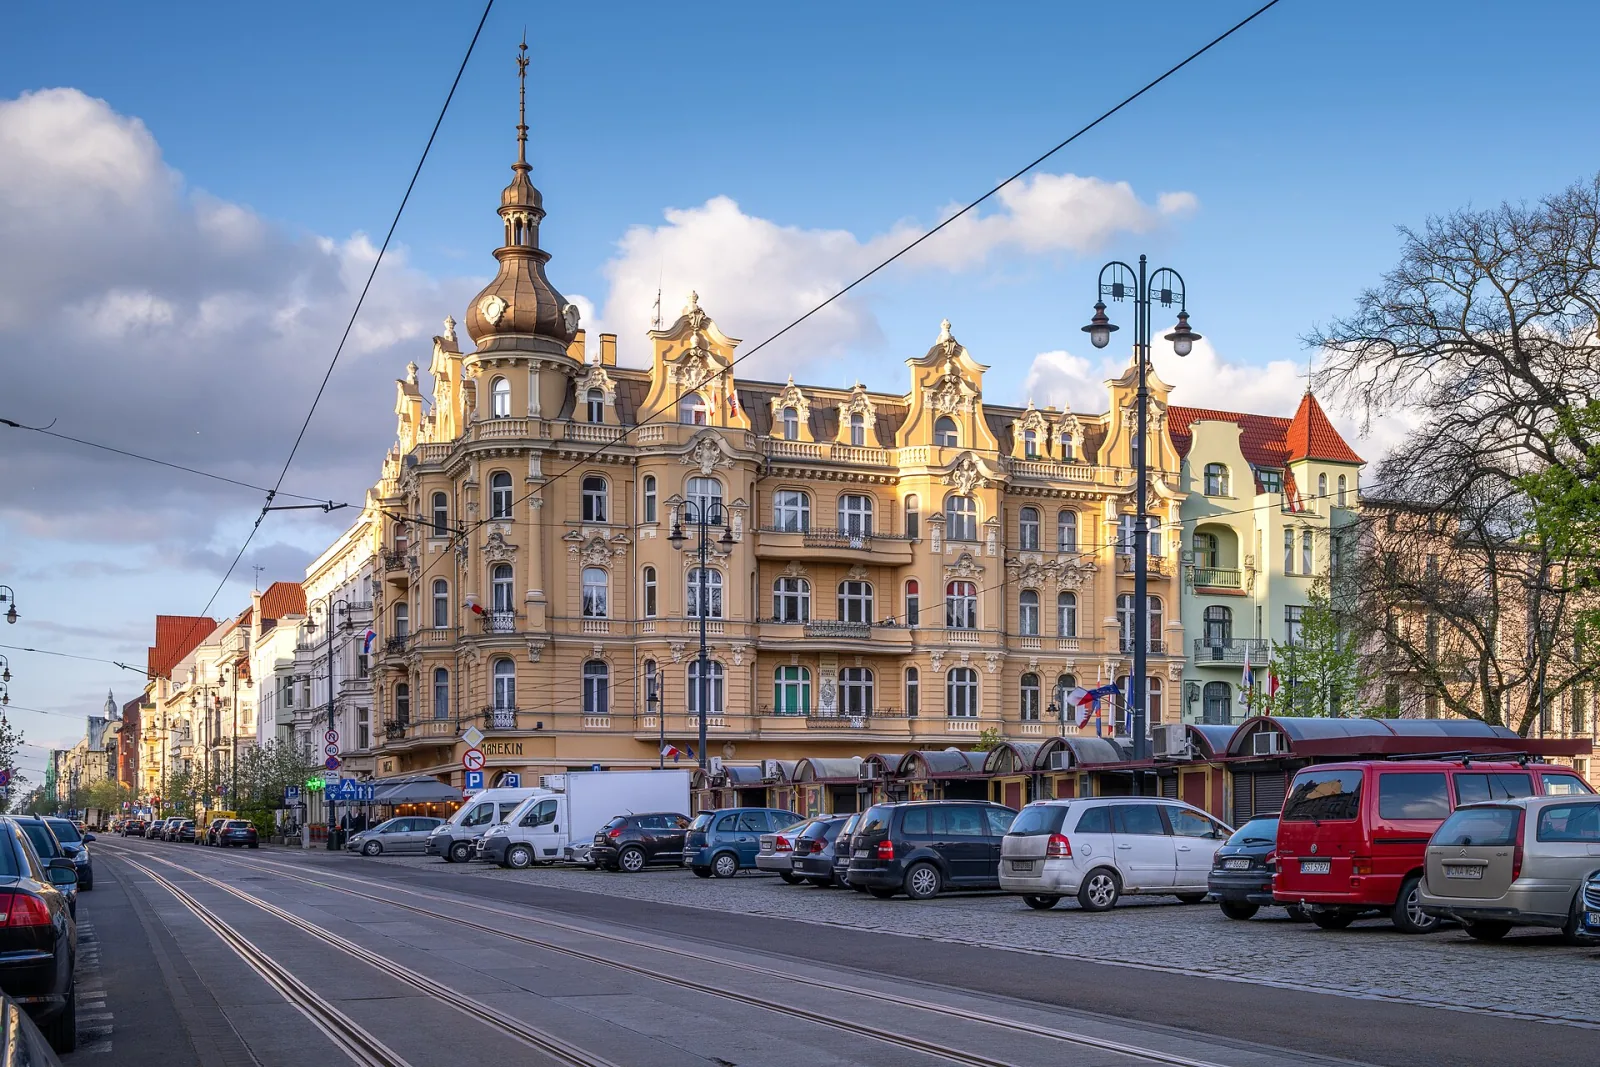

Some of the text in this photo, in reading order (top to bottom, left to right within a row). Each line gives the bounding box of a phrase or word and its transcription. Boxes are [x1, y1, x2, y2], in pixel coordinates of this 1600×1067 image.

[481, 743, 523, 755] MANEKIN
[469, 773, 480, 787] P
[508, 776, 516, 787] P
[288, 786, 296, 796] P
